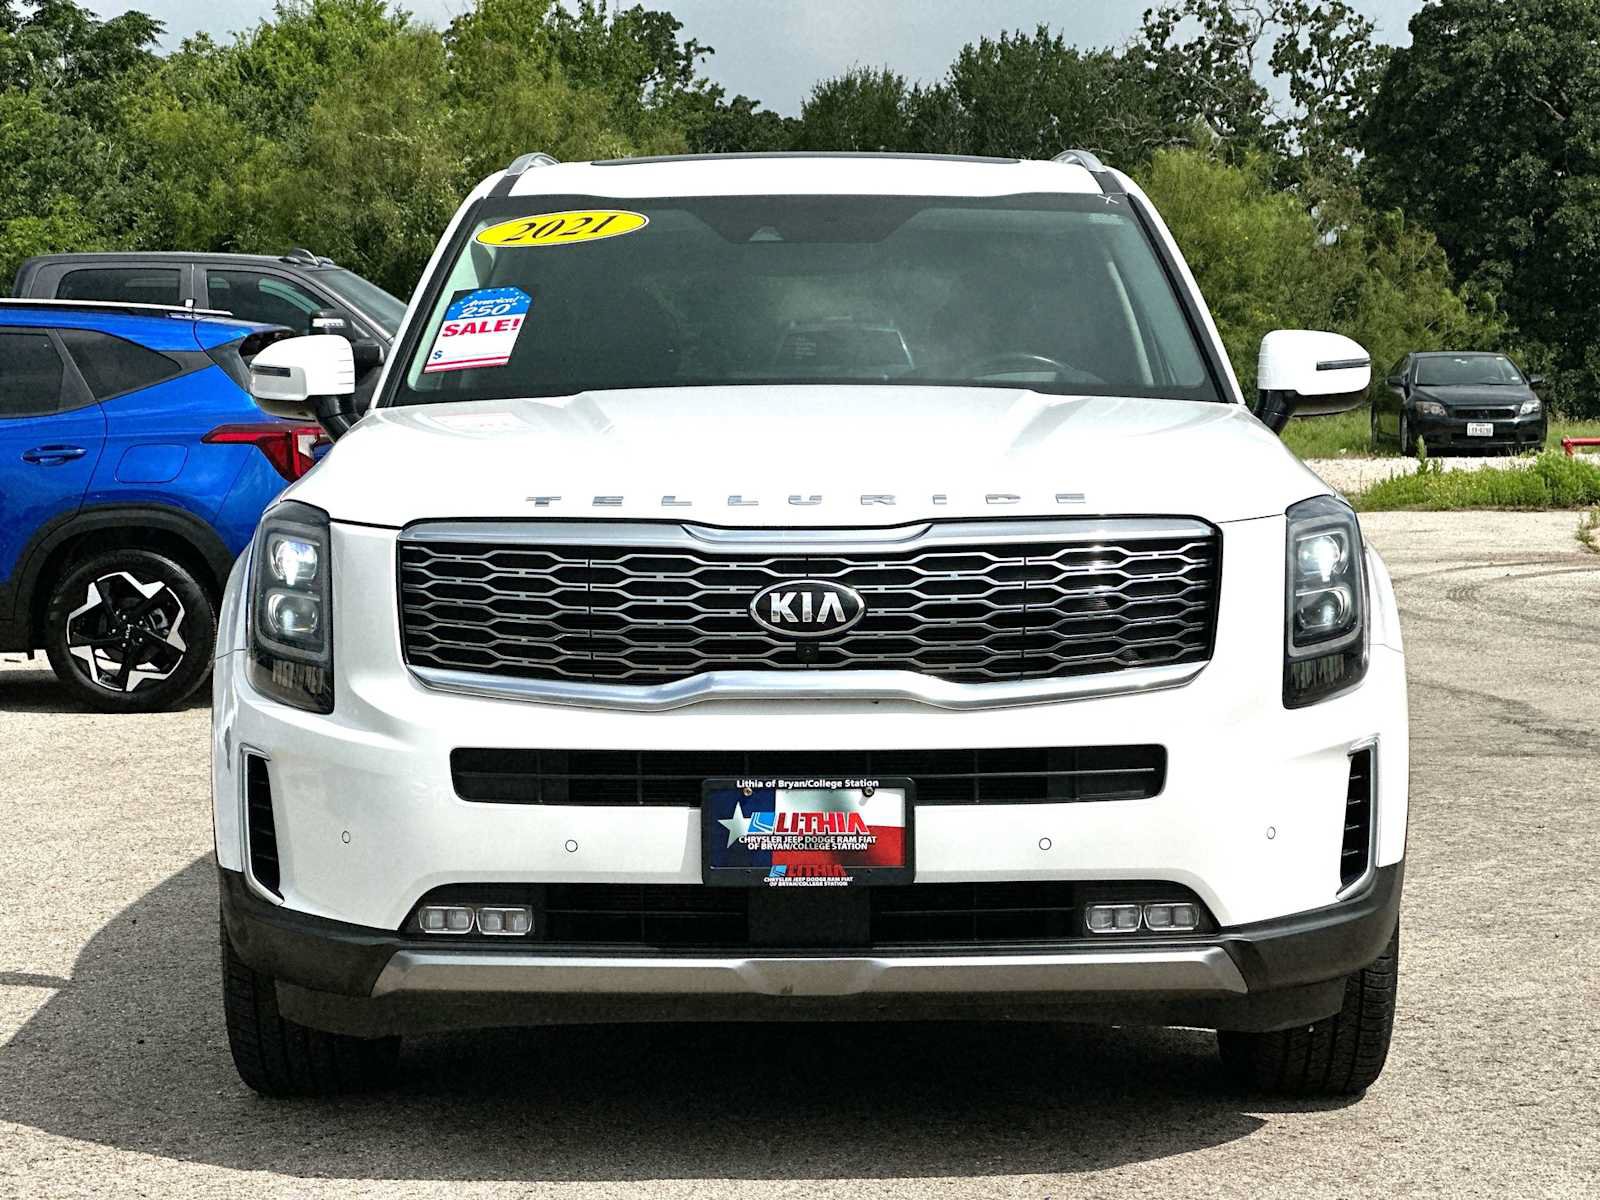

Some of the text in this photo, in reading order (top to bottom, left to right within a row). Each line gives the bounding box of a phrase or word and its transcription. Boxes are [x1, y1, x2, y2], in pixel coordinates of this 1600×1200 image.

[502, 214, 618, 242] 2021
[442, 318, 520, 337] SALE!
[526, 493, 1085, 507] TELLURIDE
[769, 592, 846, 624] KIA
[736, 779, 879, 789] Lithia of Bryan/College Station
[775, 811, 870, 835] LITHIA
[787, 865, 848, 876] LITHIA
